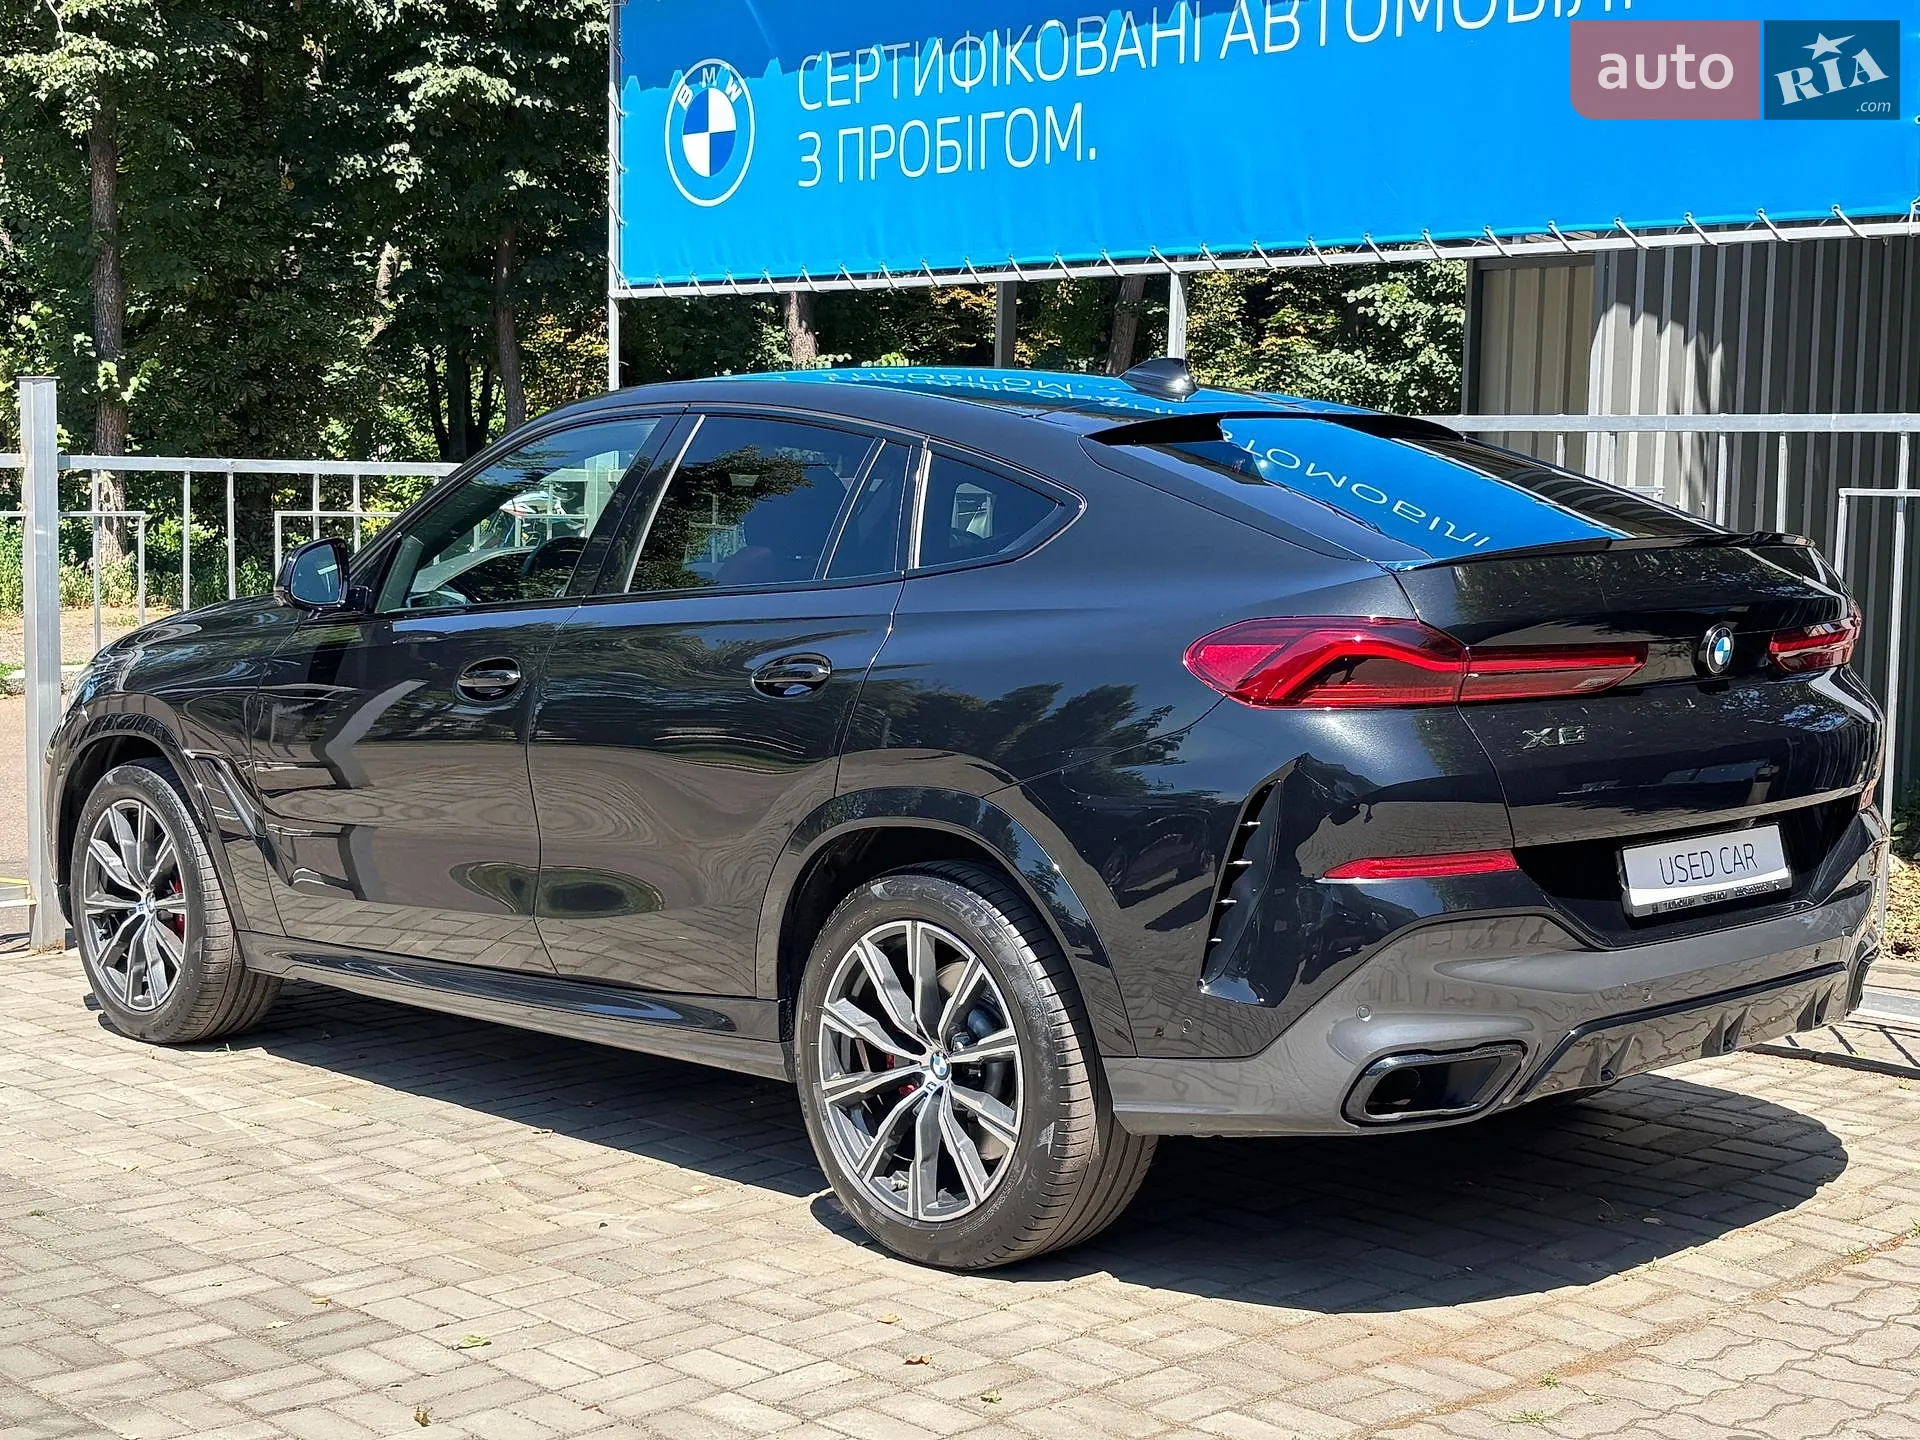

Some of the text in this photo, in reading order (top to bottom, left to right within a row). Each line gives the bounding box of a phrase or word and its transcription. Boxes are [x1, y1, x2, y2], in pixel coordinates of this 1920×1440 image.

[798, 1, 1201, 111] СЕРТИФІКОВАНІ
[676, 66, 743, 111] BMW
[798, 102, 1097, 188] З ПРОБІГОМ.
[1521, 725, 1586, 750] X6
[1659, 843, 1758, 885] USED CAR
